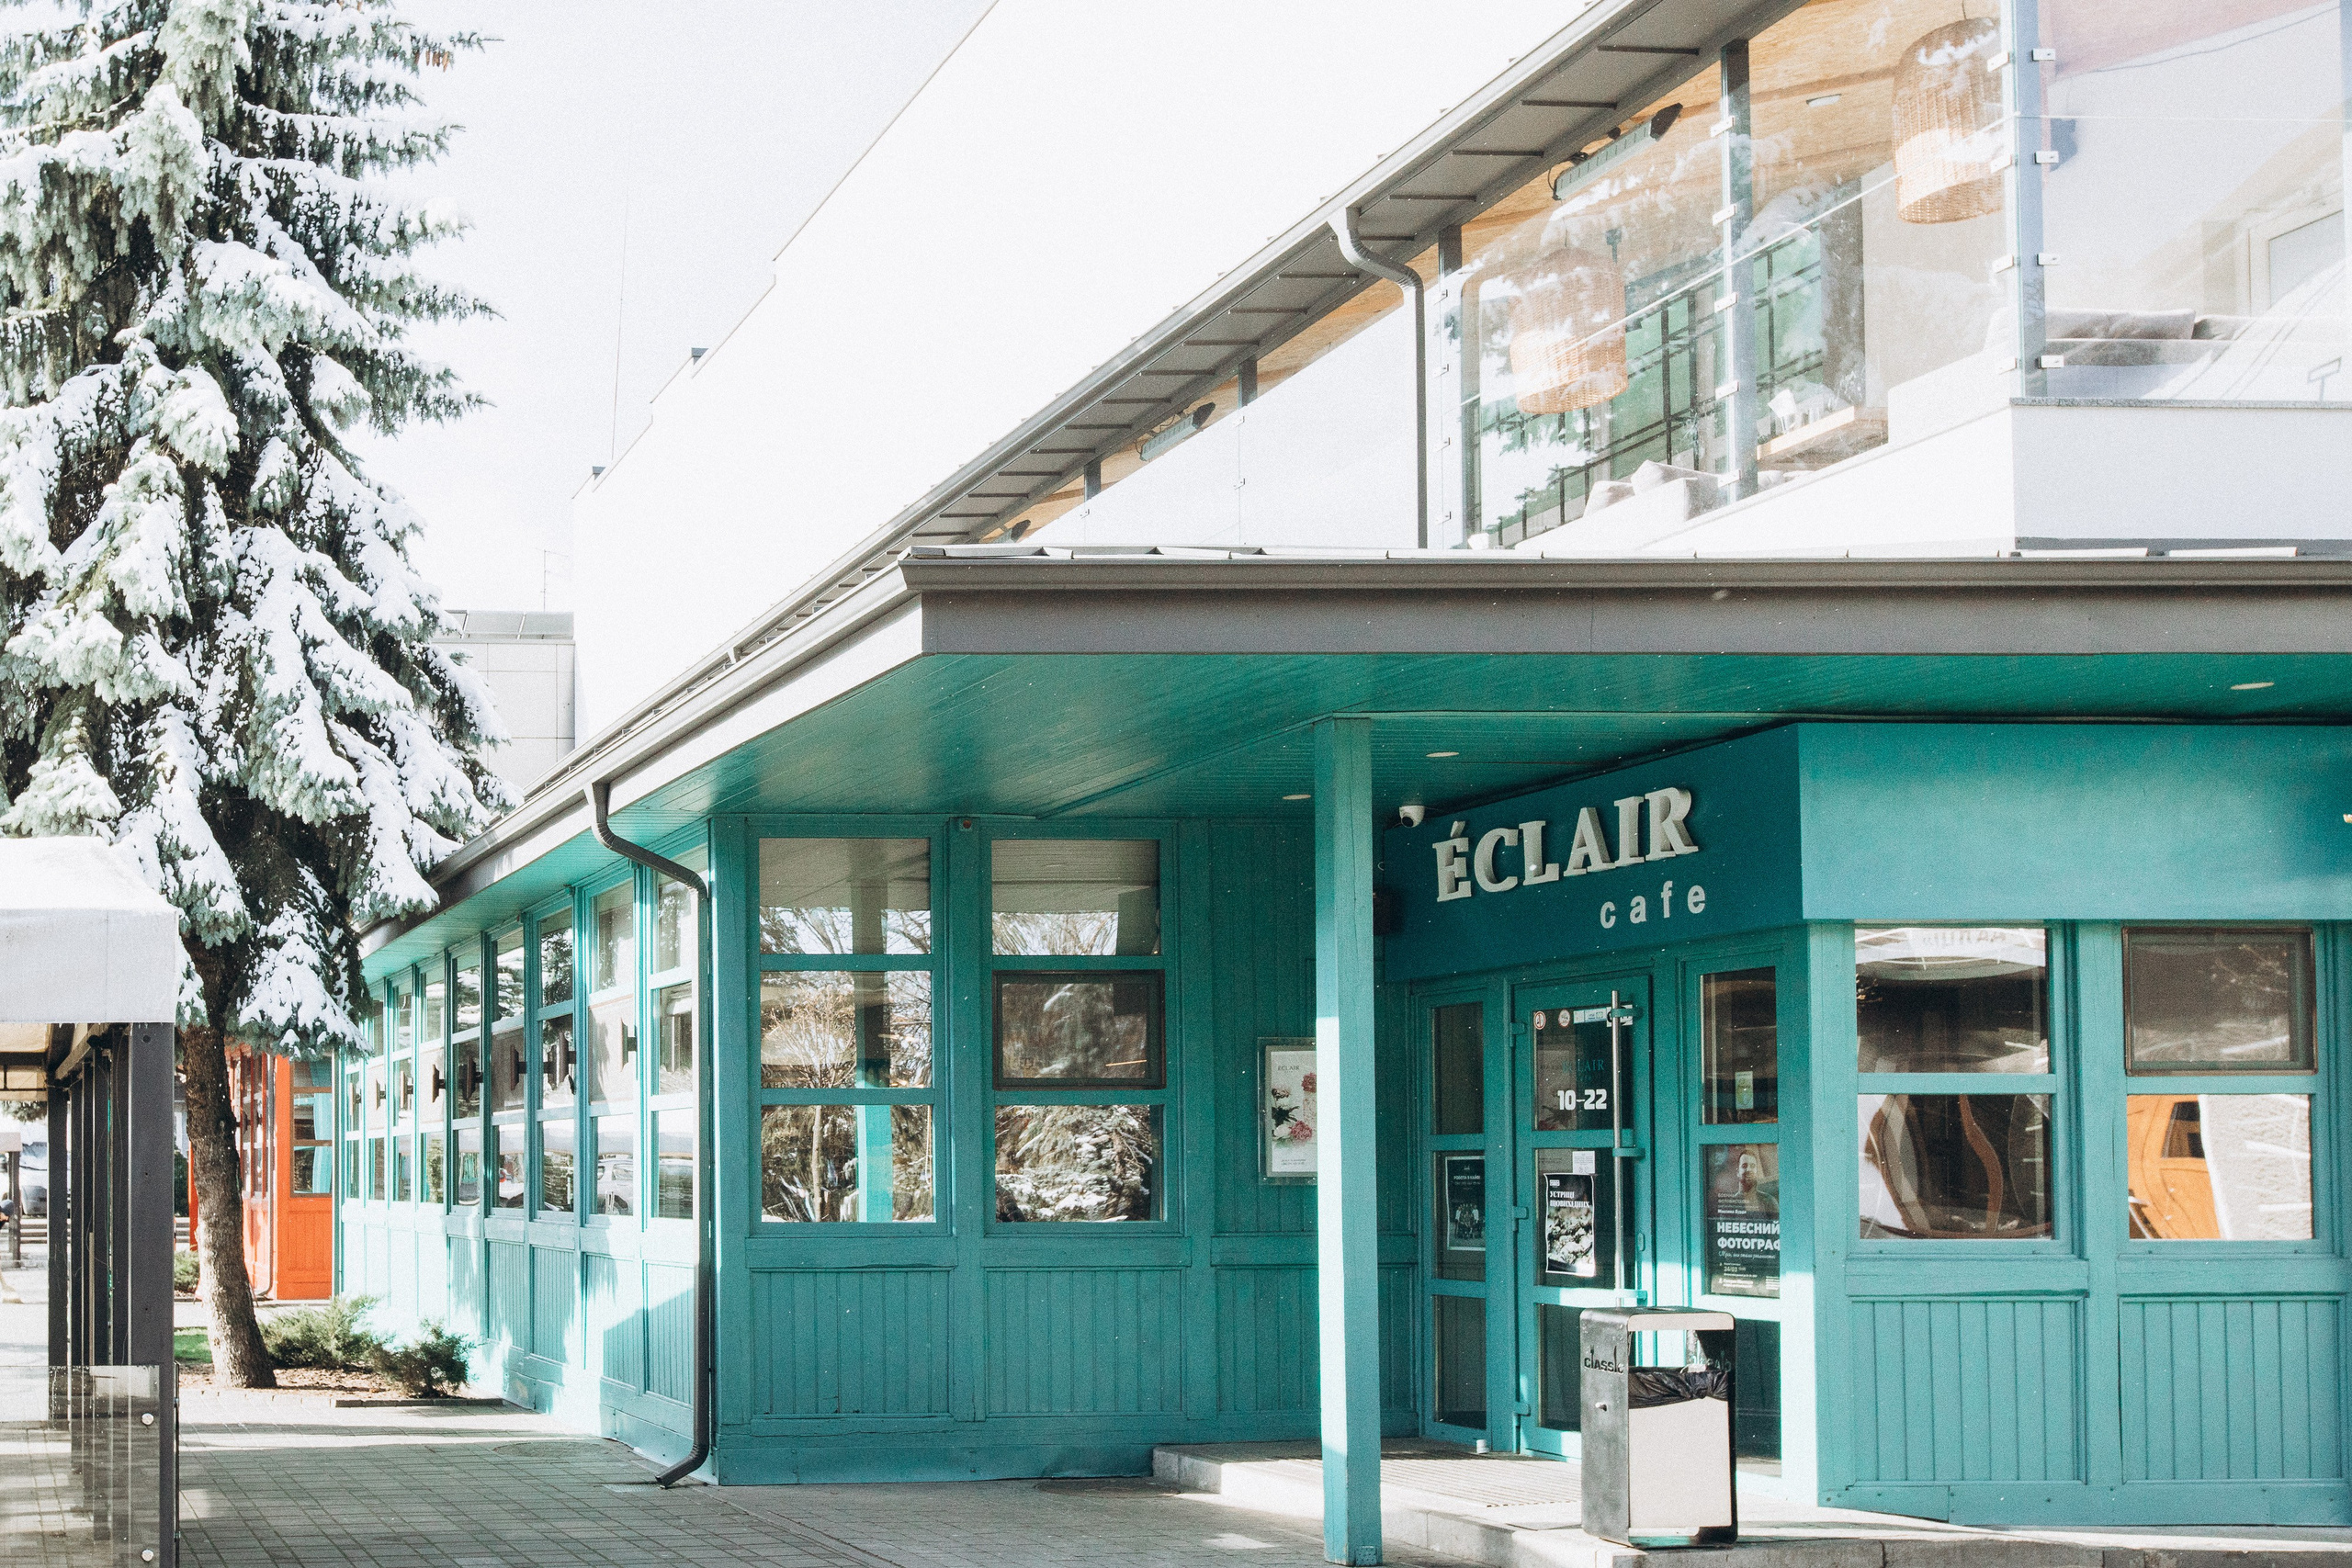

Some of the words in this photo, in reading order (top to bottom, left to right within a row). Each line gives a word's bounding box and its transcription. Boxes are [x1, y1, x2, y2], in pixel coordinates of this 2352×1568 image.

[1431, 786, 1699, 903] ÉCLAIR
[1600, 880, 1706, 930] cafe
[1557, 1089, 1607, 1111] 10-22
[1717, 1221, 1780, 1235] НЕБЕСНИЙ
